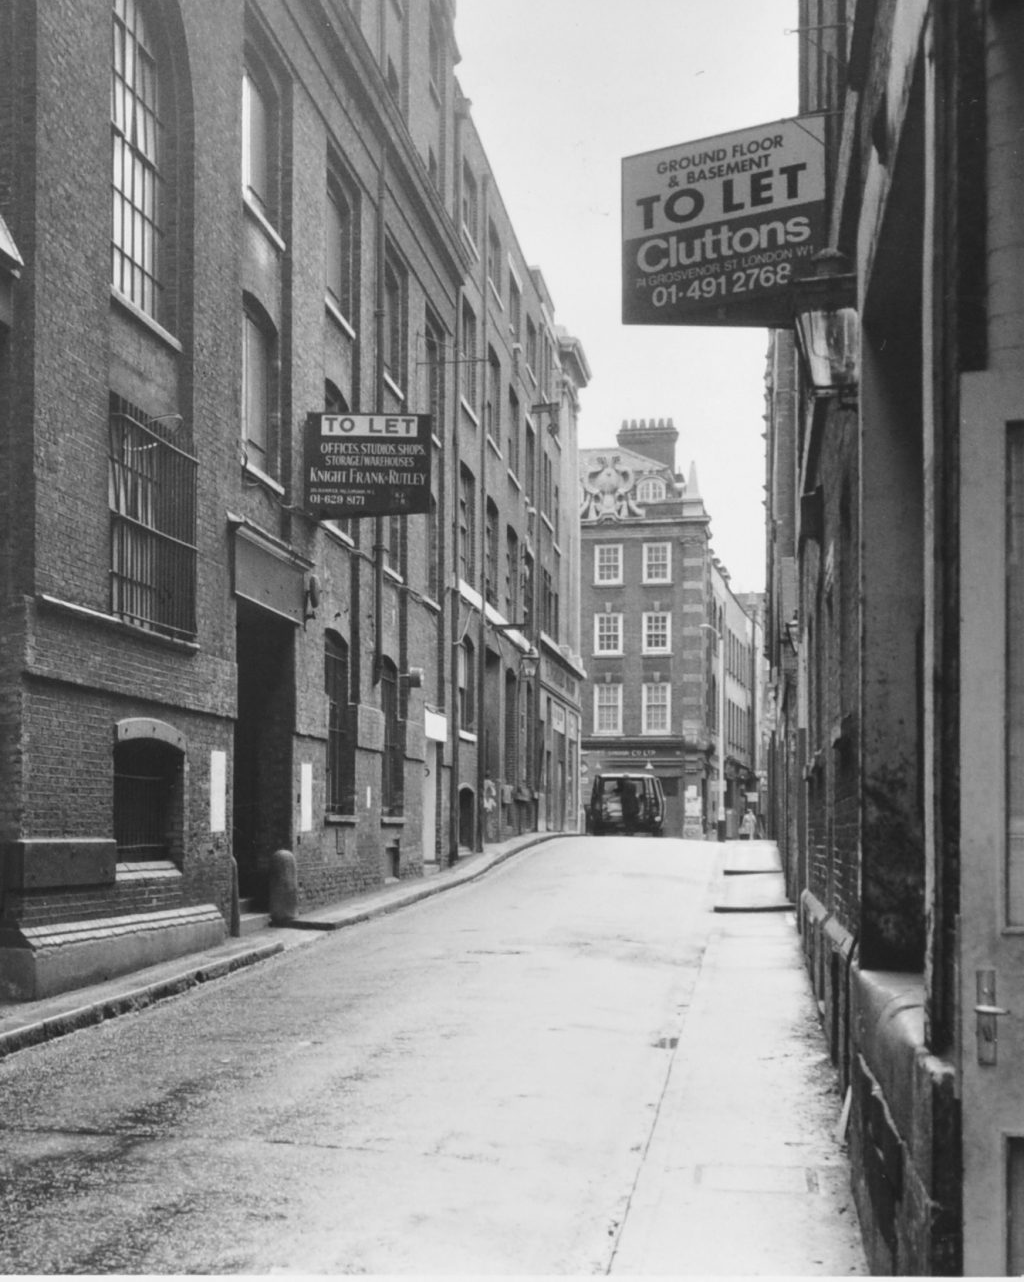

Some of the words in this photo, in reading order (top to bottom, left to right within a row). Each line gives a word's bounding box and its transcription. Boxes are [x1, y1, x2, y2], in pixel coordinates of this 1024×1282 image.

[656, 149, 727, 175] GROUND
[732, 135, 784, 158] FLOOR
[668, 176, 680, 188] &
[687, 154, 772, 184] BASEMENT
[636, 188, 704, 230] TO
[723, 162, 807, 214] LET
[637, 216, 812, 273] Cluttons
[648, 263, 720, 286] GROSVENOR
[724, 259, 737, 271] ST
[742, 248, 793, 267] LONDON
[732, 263, 792, 292] 2768
[324, 416, 356, 433] TO
[369, 417, 416, 435] LET
[310, 467, 347, 483] KNIGHT
[346, 495, 365, 505] 8171
